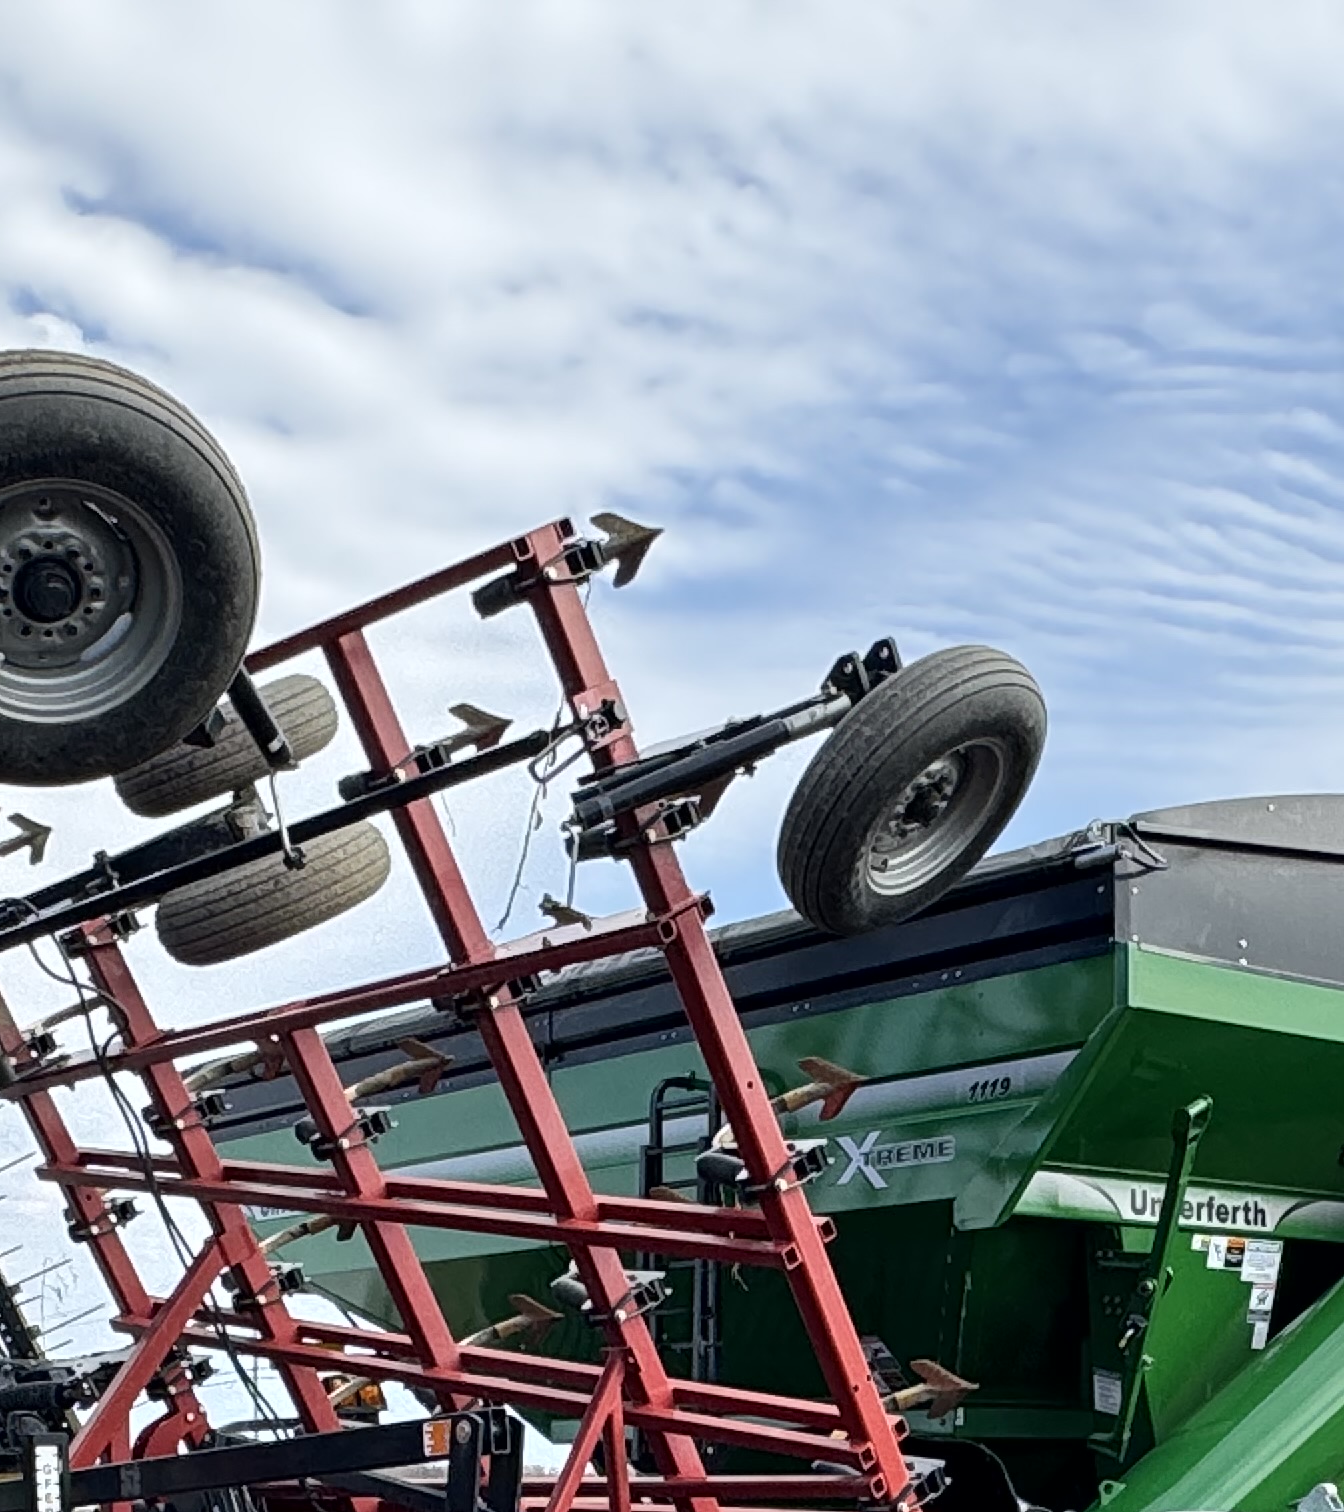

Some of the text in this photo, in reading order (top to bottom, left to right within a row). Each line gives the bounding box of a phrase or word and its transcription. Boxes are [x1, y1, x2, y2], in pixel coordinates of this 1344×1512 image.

[967, 1076, 1013, 1101] 1119
[835, 1130, 956, 1190] XTREME
[1130, 1188, 1268, 1228] Unerferth
